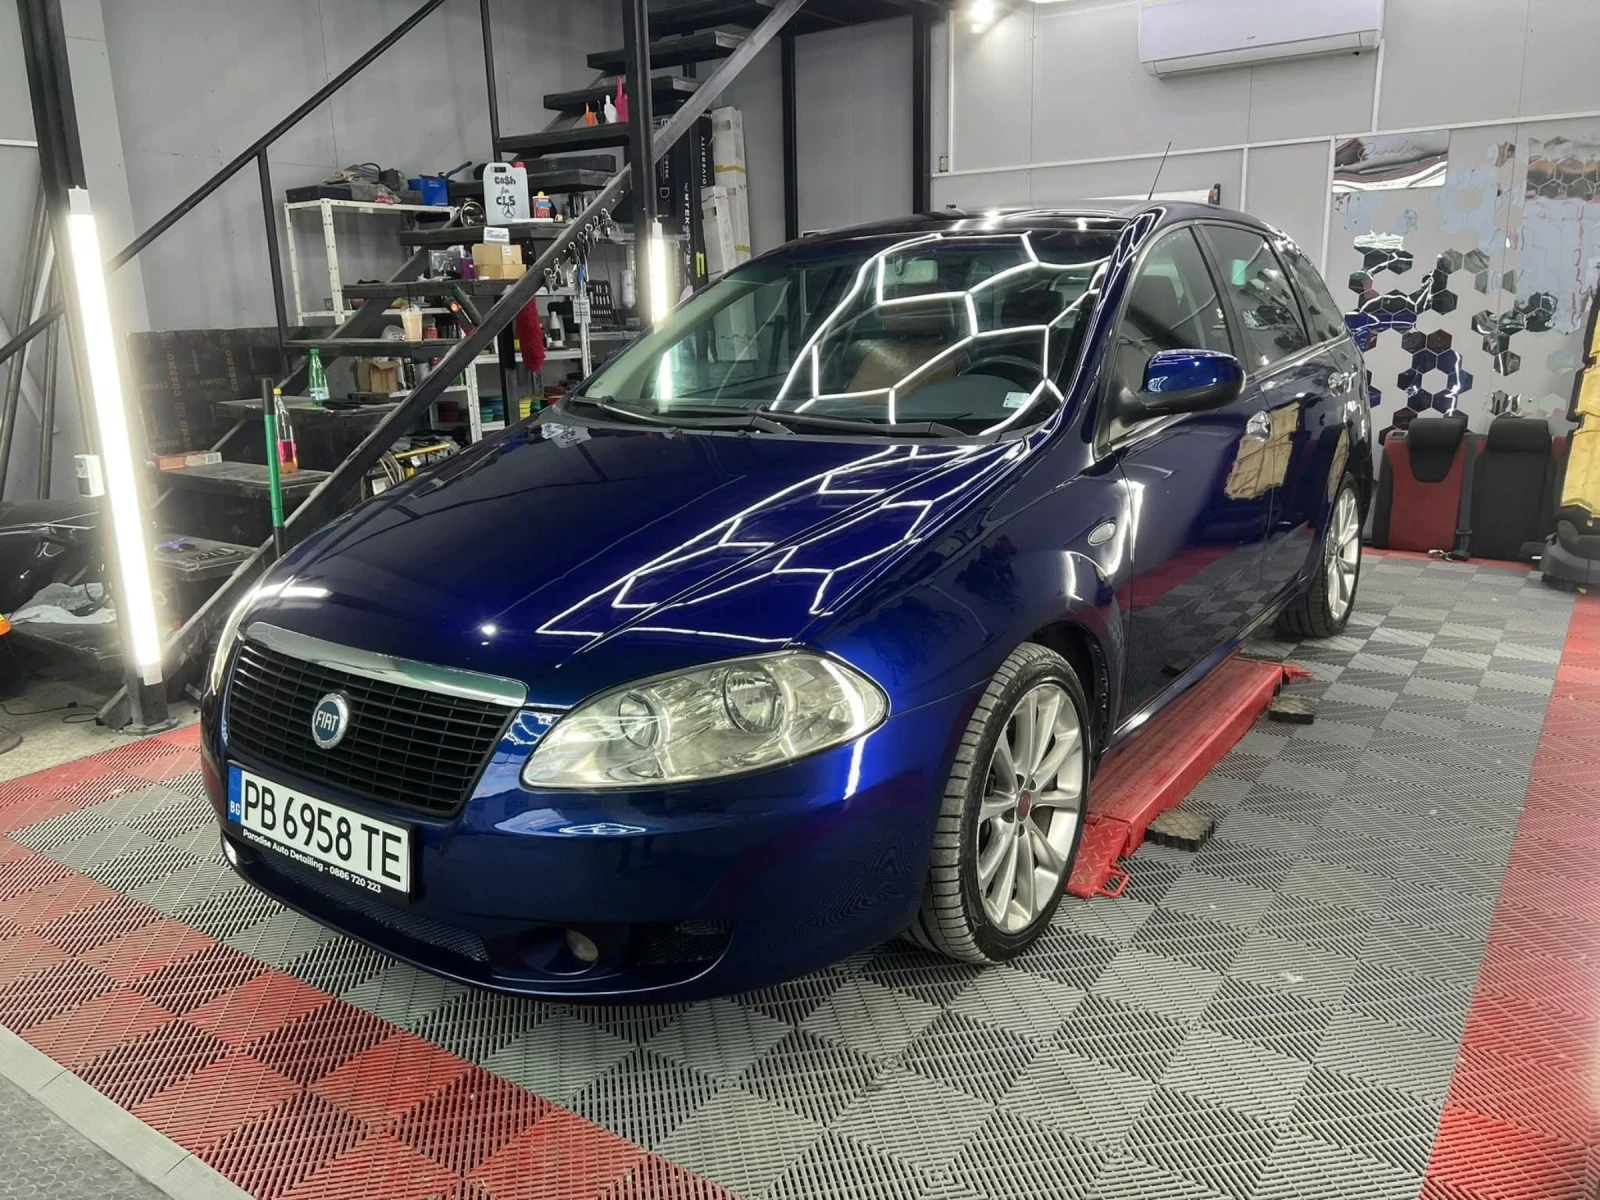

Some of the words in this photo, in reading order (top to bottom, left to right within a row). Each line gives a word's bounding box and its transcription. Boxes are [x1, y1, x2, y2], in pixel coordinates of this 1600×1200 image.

[495, 195, 516, 206] CLS
[315, 710, 339, 732] FIAT
[230, 800, 241, 816] BG
[244, 779, 276, 831] PB
[283, 796, 352, 861] 6958
[360, 823, 402, 883] TE
[243, 828, 272, 848] Paradise
[272, 842, 289, 856] Auto
[289, 849, 324, 872] Detailing
[329, 866, 350, 880] 0886
[350, 874, 366, 887] 720
[367, 880, 382, 893] 223
